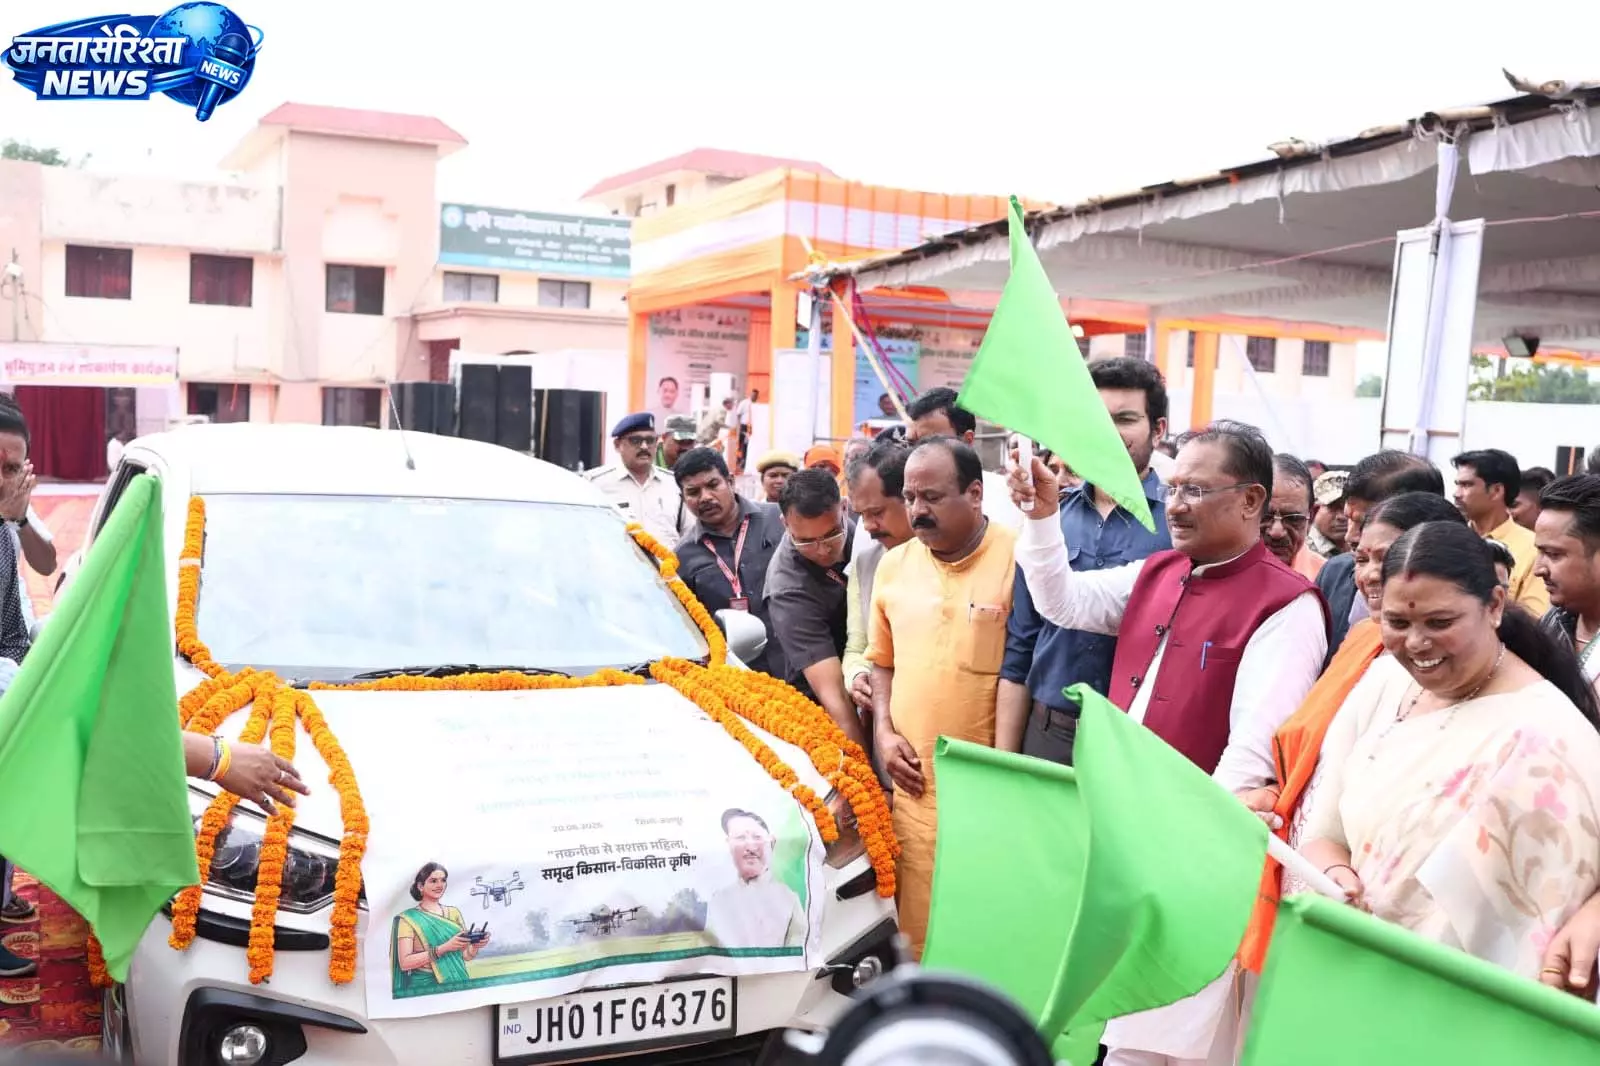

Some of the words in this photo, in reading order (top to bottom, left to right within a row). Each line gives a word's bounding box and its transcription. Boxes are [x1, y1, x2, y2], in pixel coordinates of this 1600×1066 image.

[600, 842, 613, 855] से
[615, 841, 649, 854] सशक्त
[649, 838, 688, 852] महिला,
[541, 864, 574, 883] समृद्ध
[668, 852, 697, 871] कृषि"
[526, 988, 726, 1044] JH01FG4376
[503, 1023, 522, 1035] IND
